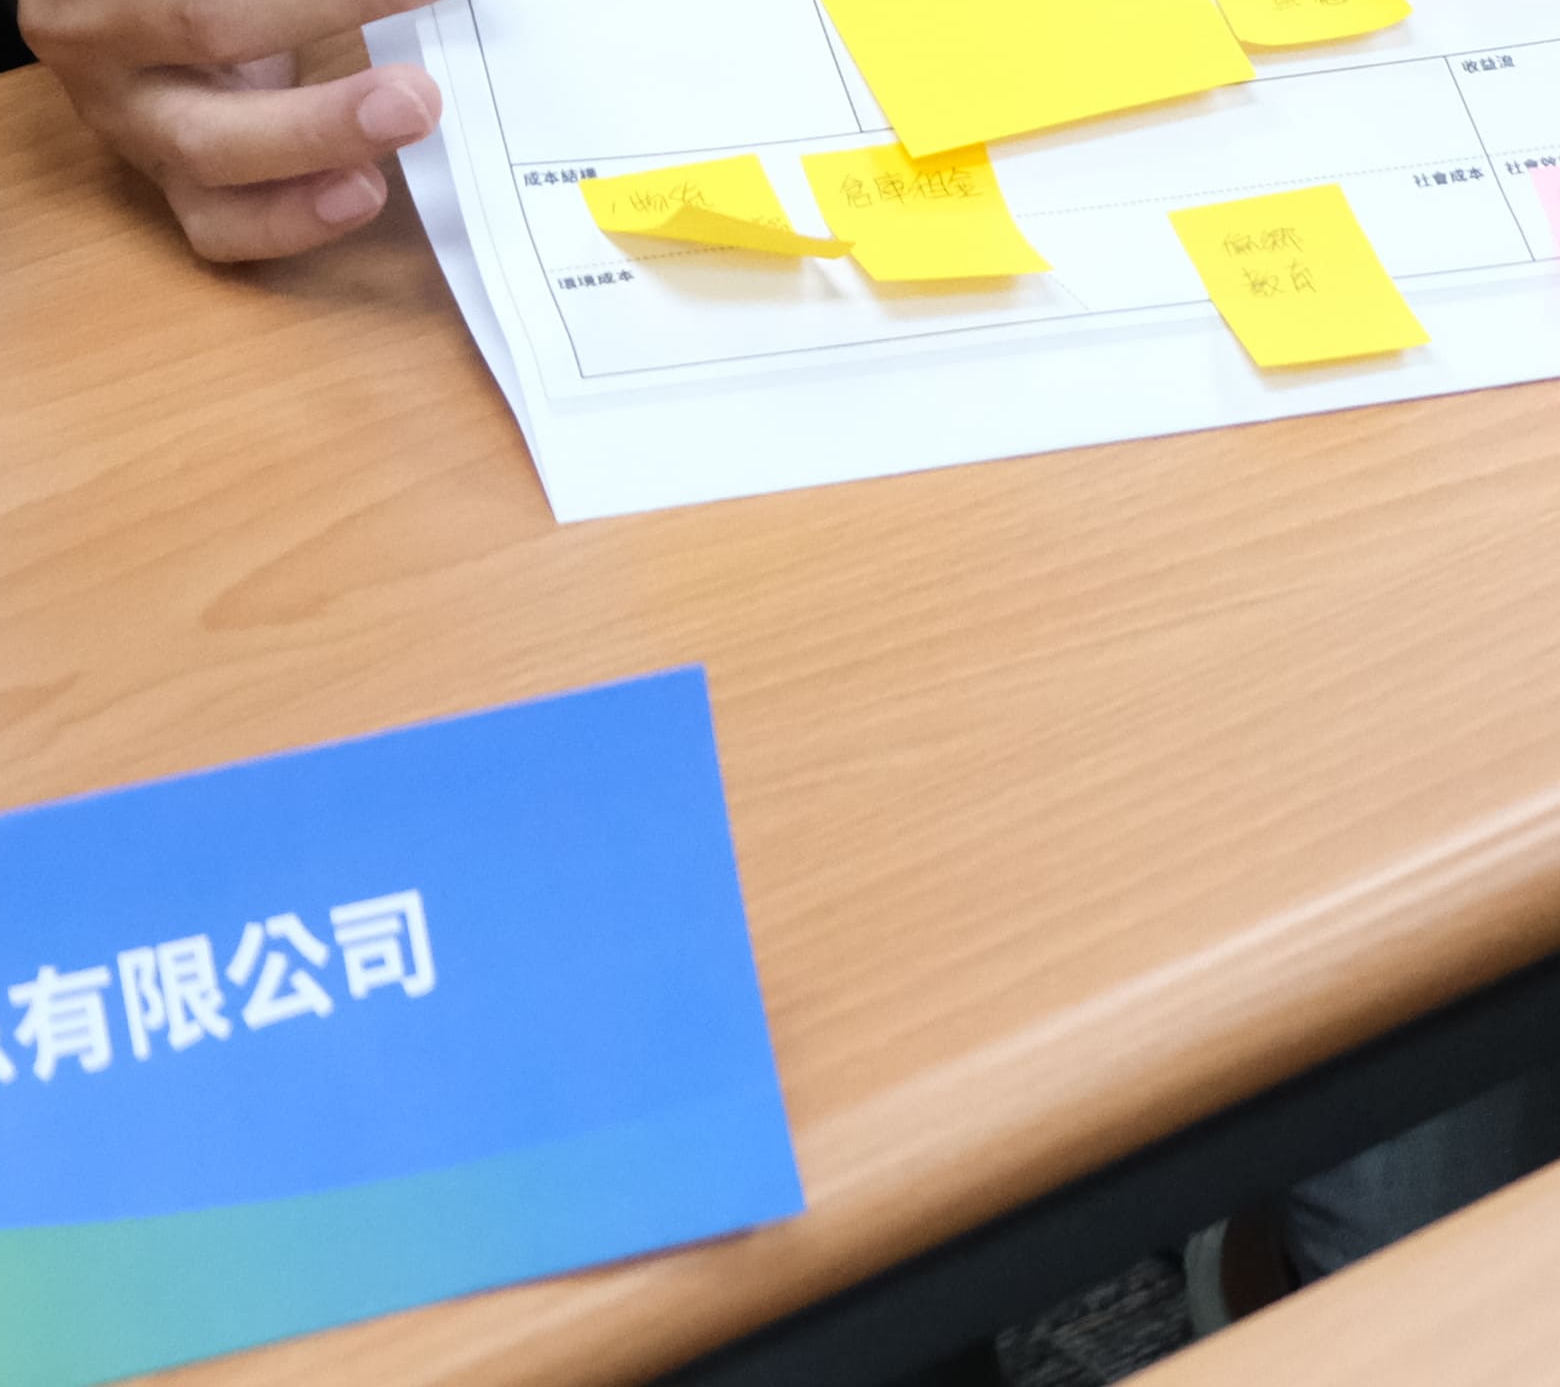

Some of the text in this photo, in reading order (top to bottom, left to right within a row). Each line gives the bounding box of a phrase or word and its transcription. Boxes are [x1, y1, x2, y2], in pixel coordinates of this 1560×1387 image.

[1461, 53, 1516, 75] 收益流
[523, 167, 598, 188] 成本結構
[1413, 165, 1485, 189] 社會成本
[558, 269, 636, 291] 環境成本
